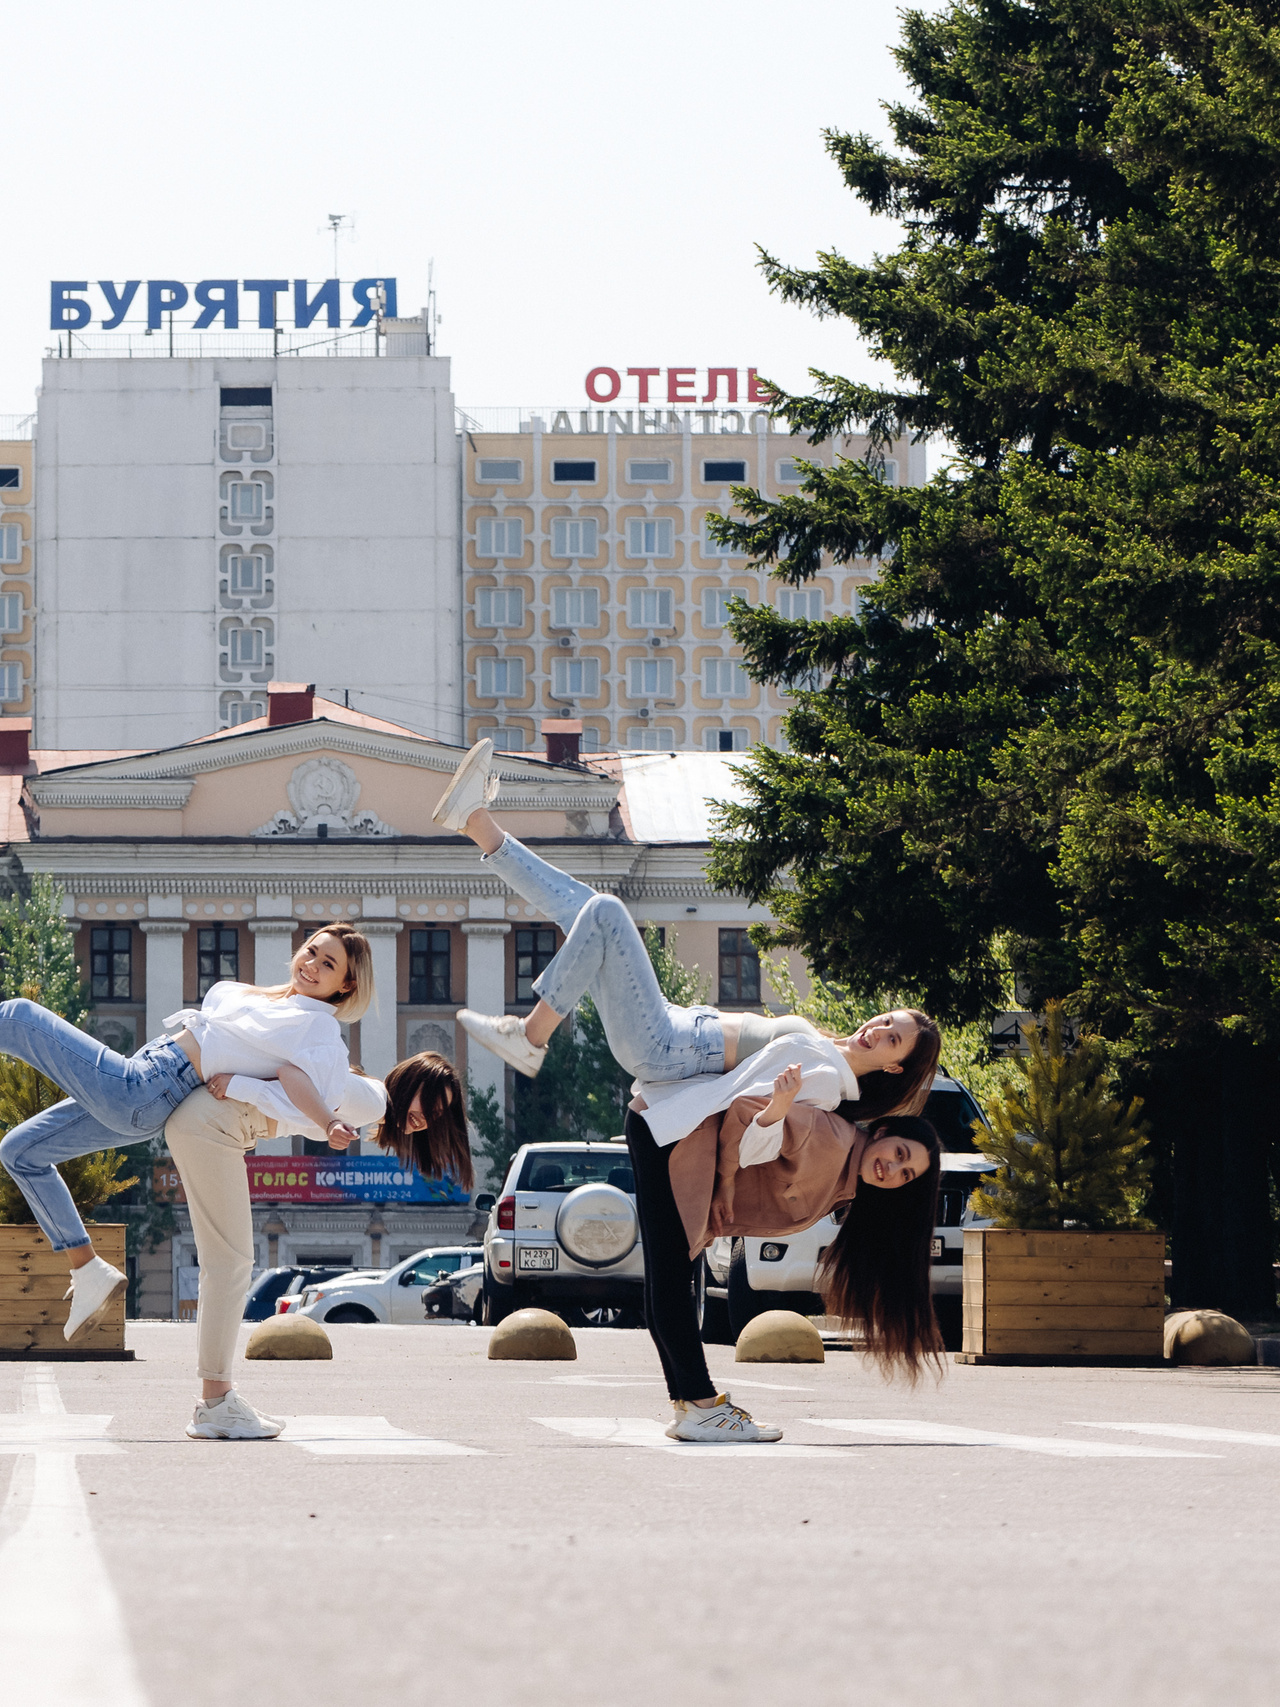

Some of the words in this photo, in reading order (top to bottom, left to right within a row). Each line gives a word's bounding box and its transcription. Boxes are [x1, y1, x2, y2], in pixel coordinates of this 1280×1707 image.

[50, 278, 398, 330] БУРЯТИЯ
[585, 366, 777, 403] ОТЕЛЬ
[160, 1173, 182, 1187] 15-
[254, 1172, 309, 1187] ГОЛОС
[315, 1171, 414, 1186] КОЧЕВНИКОВ
[373, 1190, 412, 1199] 21-32-24
